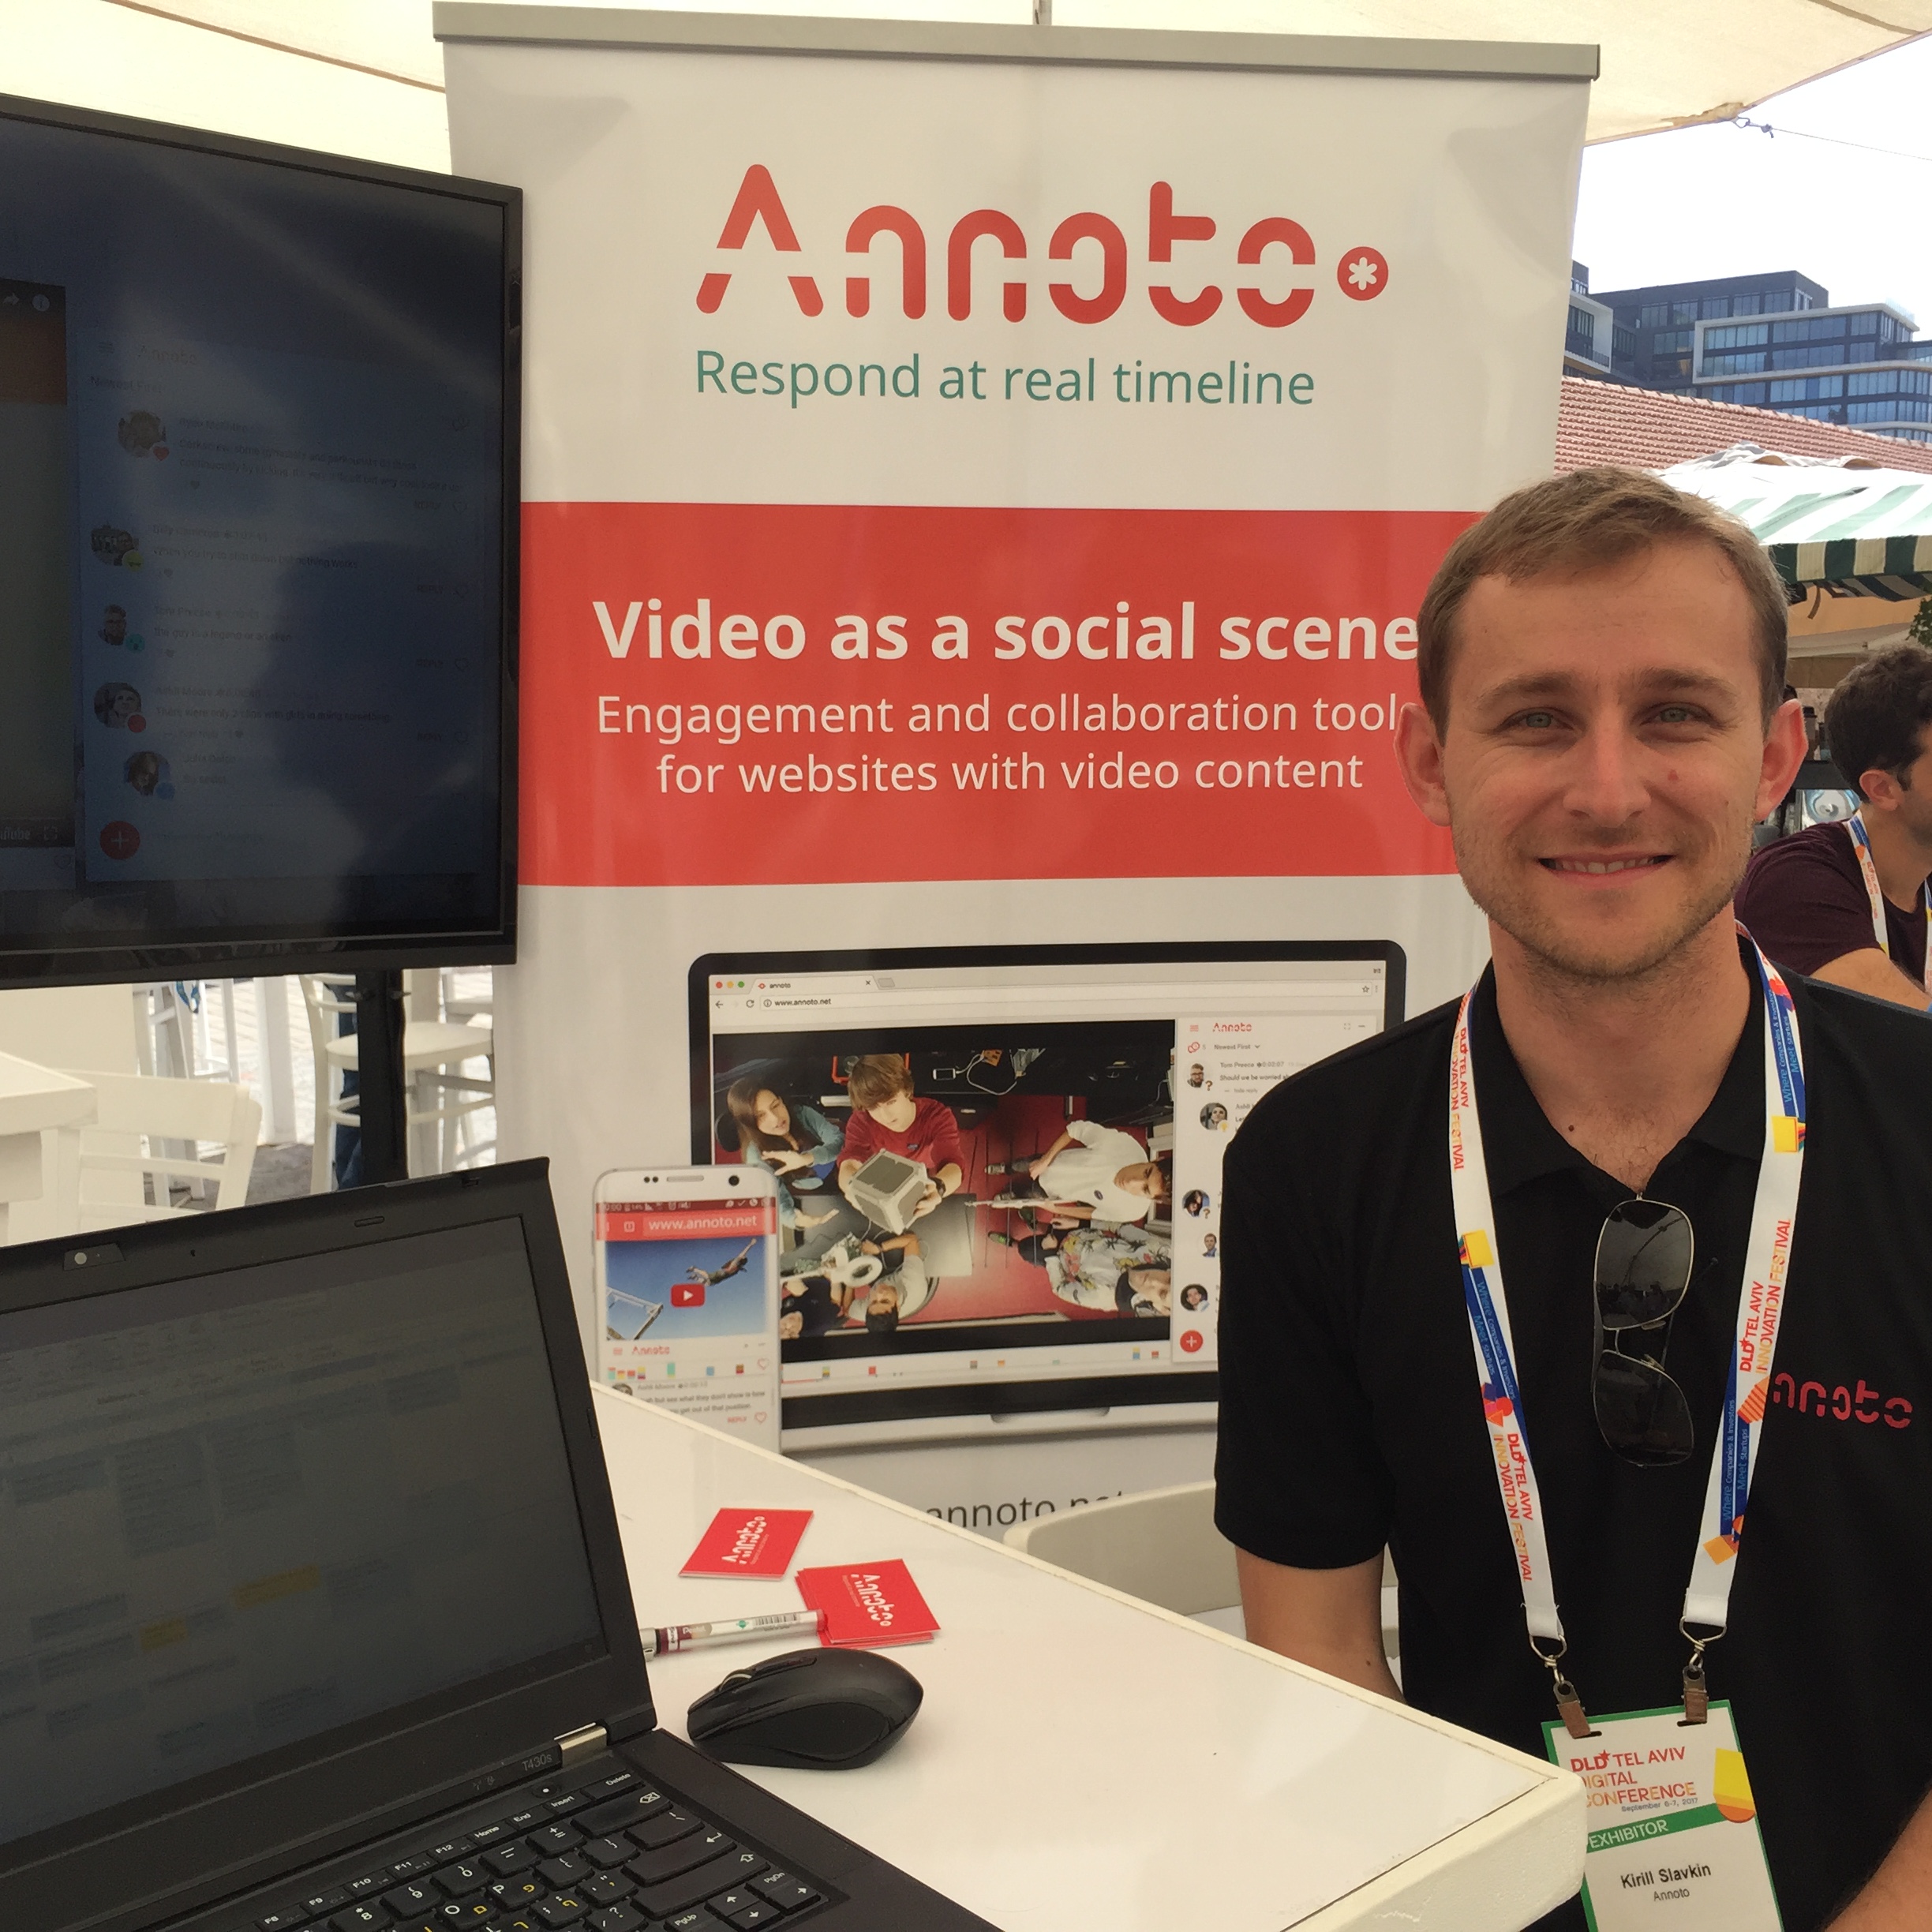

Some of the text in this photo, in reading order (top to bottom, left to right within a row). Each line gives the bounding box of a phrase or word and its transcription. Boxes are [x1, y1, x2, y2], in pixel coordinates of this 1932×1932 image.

[696, 163, 1316, 328] Annoto
[696, 350, 1316, 409] Respond at real timeline
[593, 598, 1419, 661] Video as a social scene
[597, 693, 1396, 744] Engagement and collaboration tool
[657, 751, 1364, 793] for websites with video content
[774, 998, 832, 1007] www.annoto.net
[1212, 1022, 1252, 1033] Annoto
[1459, 1027, 1469, 1054] DLD
[1788, 1046, 1799, 1073] Meet
[1460, 1080, 1470, 1108] AVIV
[1781, 1069, 1792, 1103] Where
[648, 1215, 758, 1231] www.annoto.net
[1477, 1281, 1493, 1316] Where
[1755, 1219, 1792, 1375] INNOVATION FESTIVAL
[1473, 1315, 1488, 1343] Meet
[1739, 1280, 1765, 1372] DLD TEL AVIV
[1773, 1372, 1913, 1429] nnoto
[1507, 1432, 1533, 1521] DLD TEL AVIV
[1725, 1443, 1735, 1485] Companies
[1737, 1462, 1747, 1491] Meet
[1493, 1433, 1533, 1583] INNOVATION FESTIVAL
[1723, 1485, 1732, 1521] Where
[522, 1753, 552, 1772] T430s
[1570, 1746, 1686, 1773] DLD TEL AVIV
[605, 1773, 631, 1786] Delete
[551, 1795, 575, 1808] Insert
[1621, 1803, 1661, 1813] September
[1682, 1797, 1698, 1806] 2017
[513, 1813, 532, 1822] End
[474, 1825, 500, 1839] Home
[1588, 1818, 1668, 1849] EXHIBITOR
[435, 1844, 454, 1854] F12
[395, 1861, 412, 1870] F11
[763, 1871, 785, 1885] PgDn
[1620, 1863, 1712, 1889] Kirill Slavkin
[352, 1878, 372, 1889] F10
[492, 1885, 505, 1894] P
[1653, 1888, 1690, 1902] Annoto
[674, 1913, 697, 1926] PgUp
